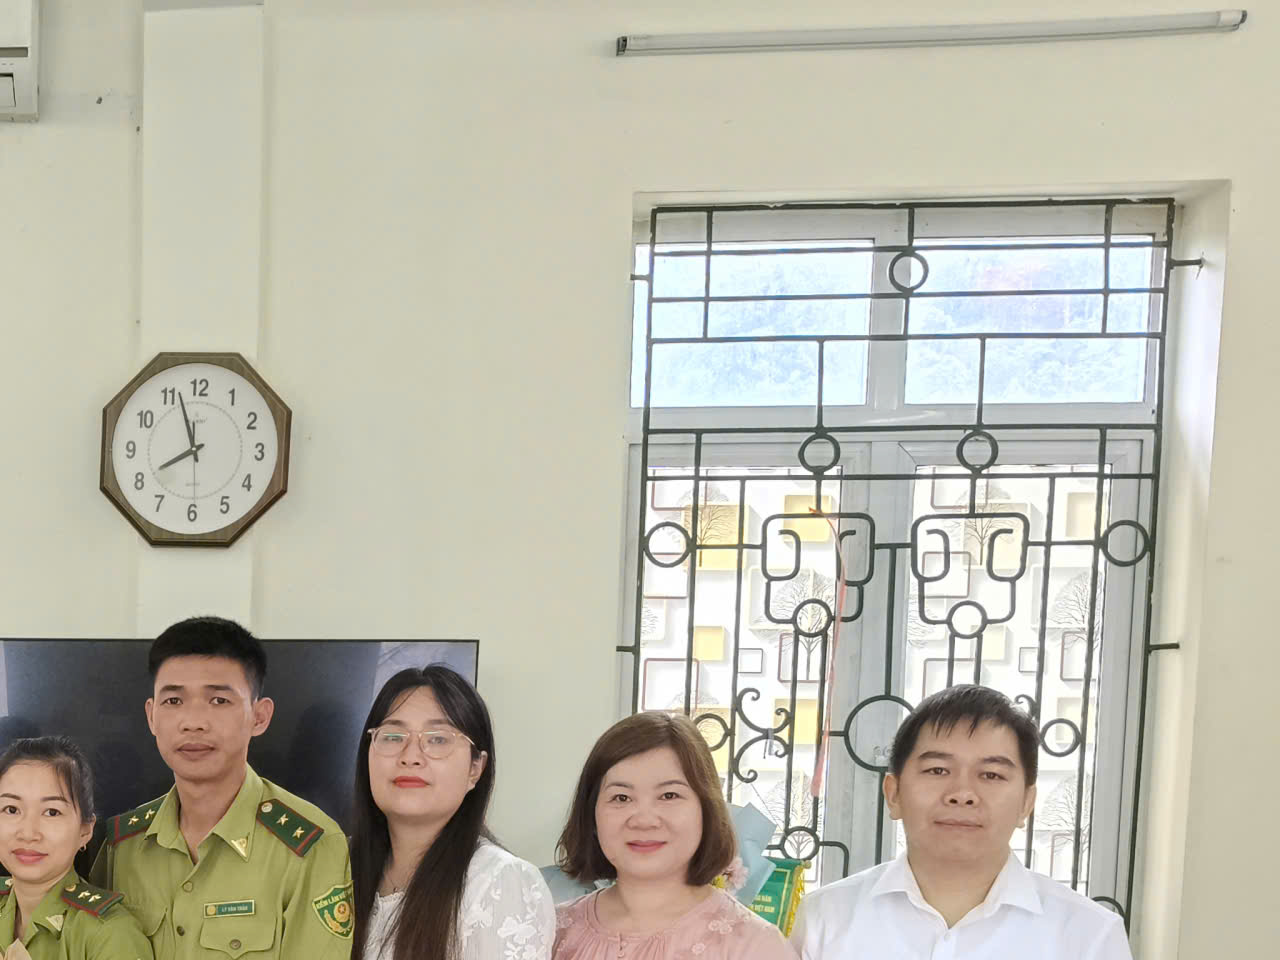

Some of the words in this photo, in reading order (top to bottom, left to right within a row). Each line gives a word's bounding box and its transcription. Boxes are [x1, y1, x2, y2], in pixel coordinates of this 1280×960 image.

[161, 387, 176, 405] 11
[190, 378, 209, 397] 12
[228, 388, 236, 406] 1
[137, 410, 154, 429] 10
[246, 411, 257, 430] 2
[125, 440, 136, 459] 9
[254, 442, 265, 461] 3
[134, 472, 145, 490] 8
[241, 473, 252, 492] 4
[154, 494, 165, 512] 7
[187, 503, 198, 522] 6
[219, 496, 230, 514] 5
